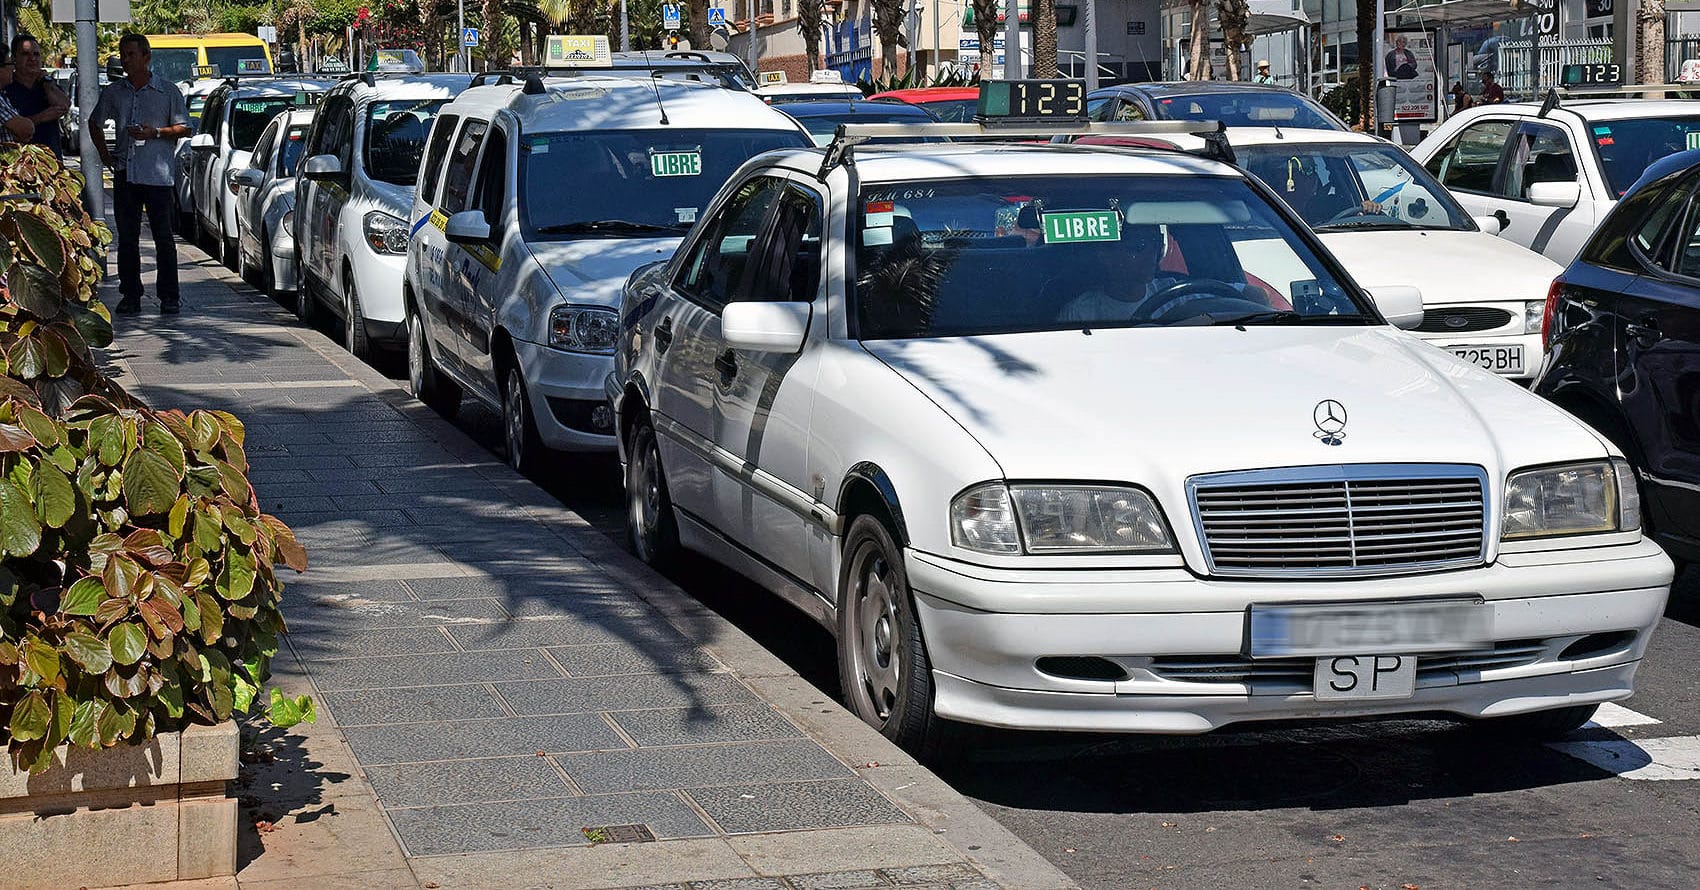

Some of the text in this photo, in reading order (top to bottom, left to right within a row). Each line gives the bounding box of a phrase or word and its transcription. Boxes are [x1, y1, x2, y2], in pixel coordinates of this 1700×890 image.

[566, 39, 590, 47] TAXI
[199, 66, 213, 75] TAXI
[247, 61, 263, 70] TAXI
[767, 73, 780, 81] TAXI
[1584, 64, 1620, 82] 123
[1017, 83, 1082, 114] 123
[654, 154, 699, 175] LIBRE
[903, 188, 936, 200] 684
[1053, 216, 1110, 238] LIBRE
